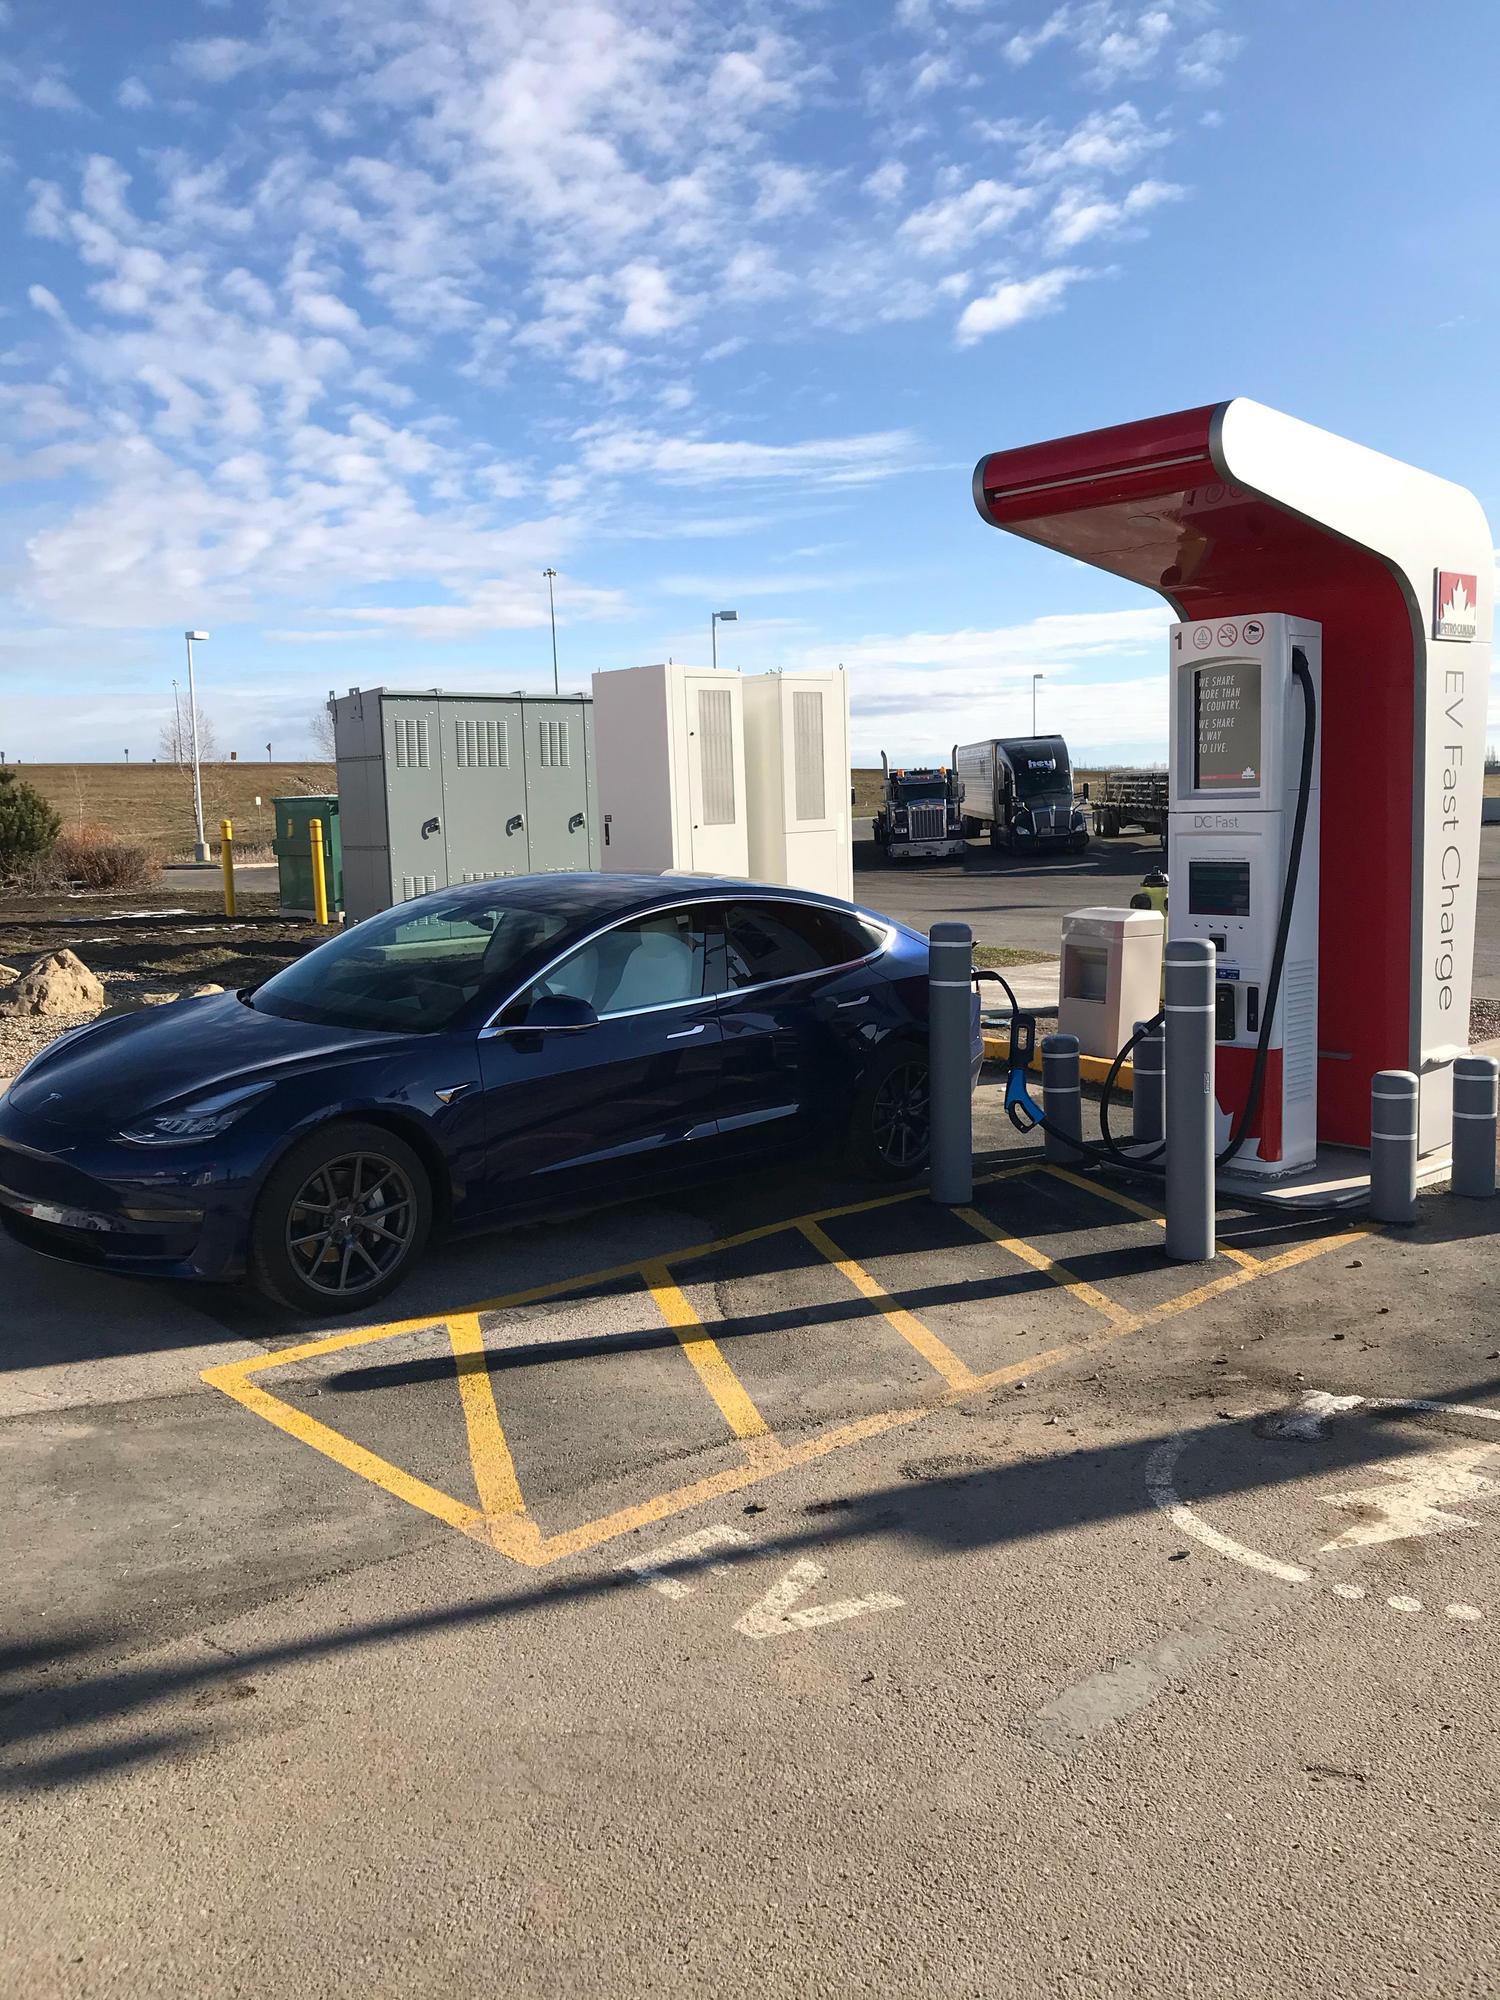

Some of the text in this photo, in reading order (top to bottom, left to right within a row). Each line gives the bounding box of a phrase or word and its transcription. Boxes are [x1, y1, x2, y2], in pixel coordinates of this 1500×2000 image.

[1174, 631, 1182, 650] 1
[1199, 675, 1235, 688] WE SHARE
[1199, 687, 1241, 700] MORE THAN
[1199, 700, 1241, 712] A COUNTRY.
[1199, 717, 1235, 729] WE SHARE
[1199, 731, 1222, 742] A WAY
[1199, 742, 1229, 754] TO LIVE.
[1194, 815, 1240, 829] DC Fast
[1435, 670, 1464, 1011] EV Fast Charge
